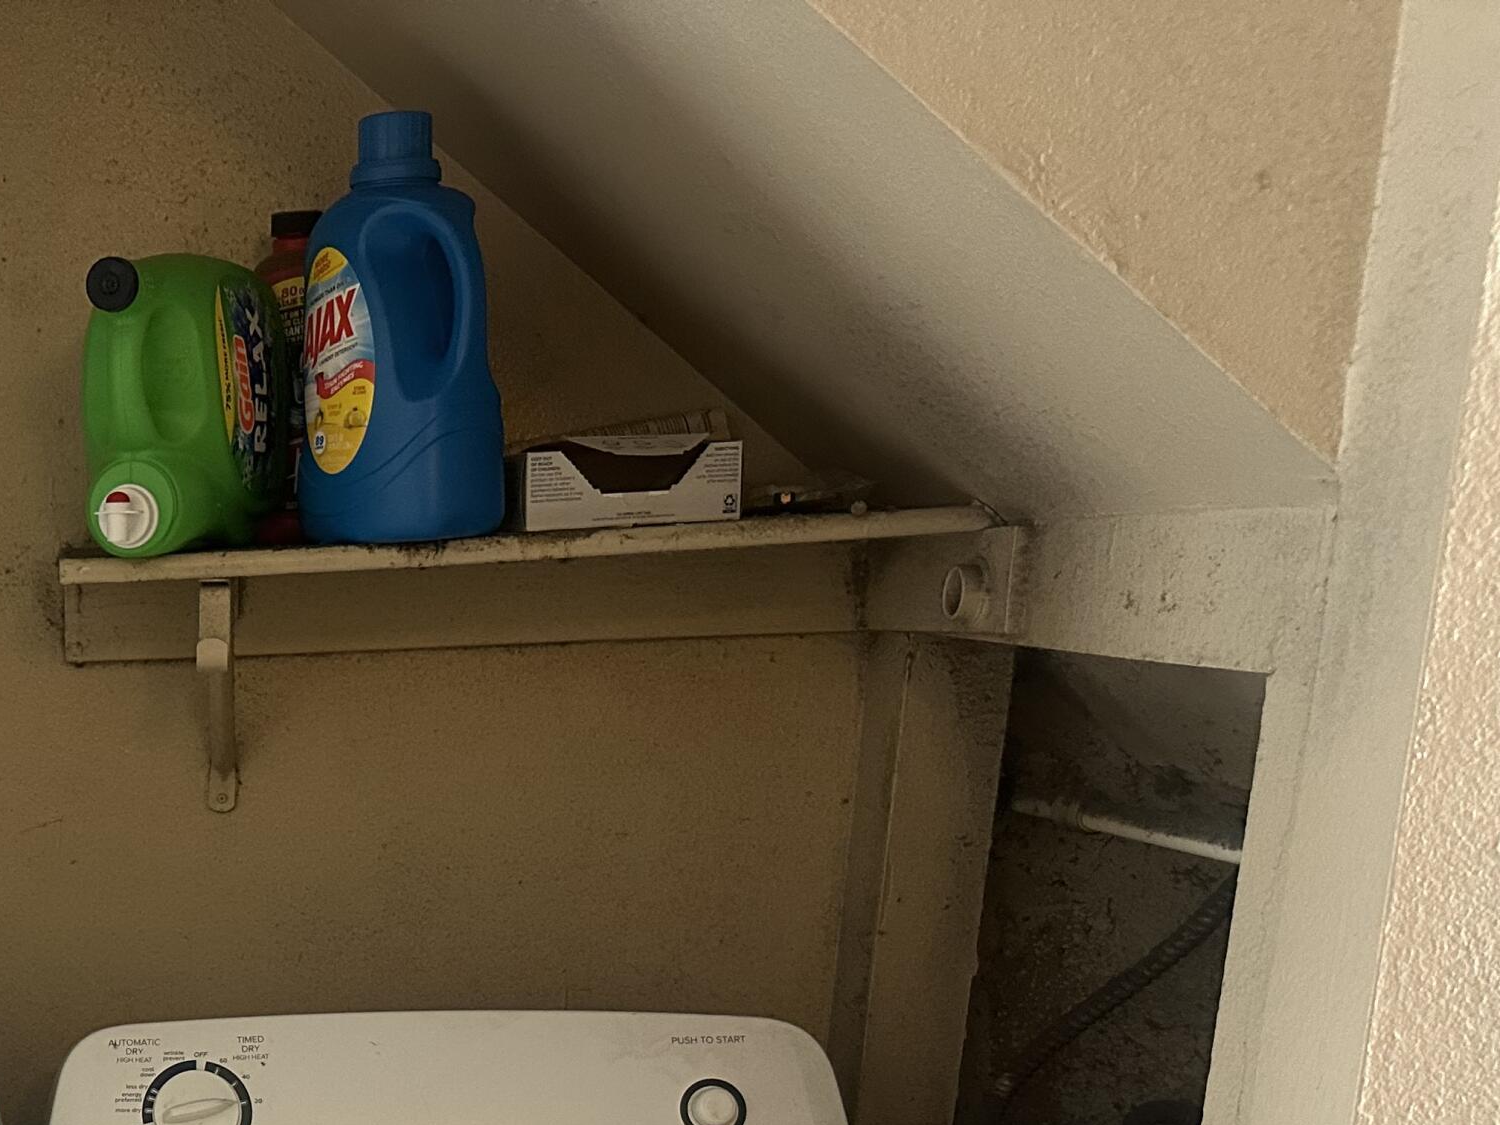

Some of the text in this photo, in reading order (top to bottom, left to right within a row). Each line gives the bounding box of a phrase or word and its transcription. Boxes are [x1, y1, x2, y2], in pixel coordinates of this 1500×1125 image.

[303, 287, 357, 368] AJAX
[234, 336, 254, 433] Gain
[245, 307, 268, 453] RELAX
[315, 435, 325, 446] 89
[108, 1038, 161, 1047] AUTOMATIC
[237, 1035, 265, 1044] TIMED
[671, 1035, 746, 1044] PUSH TO START
[125, 1047, 144, 1055] DRY
[241, 1045, 260, 1053] DRY
